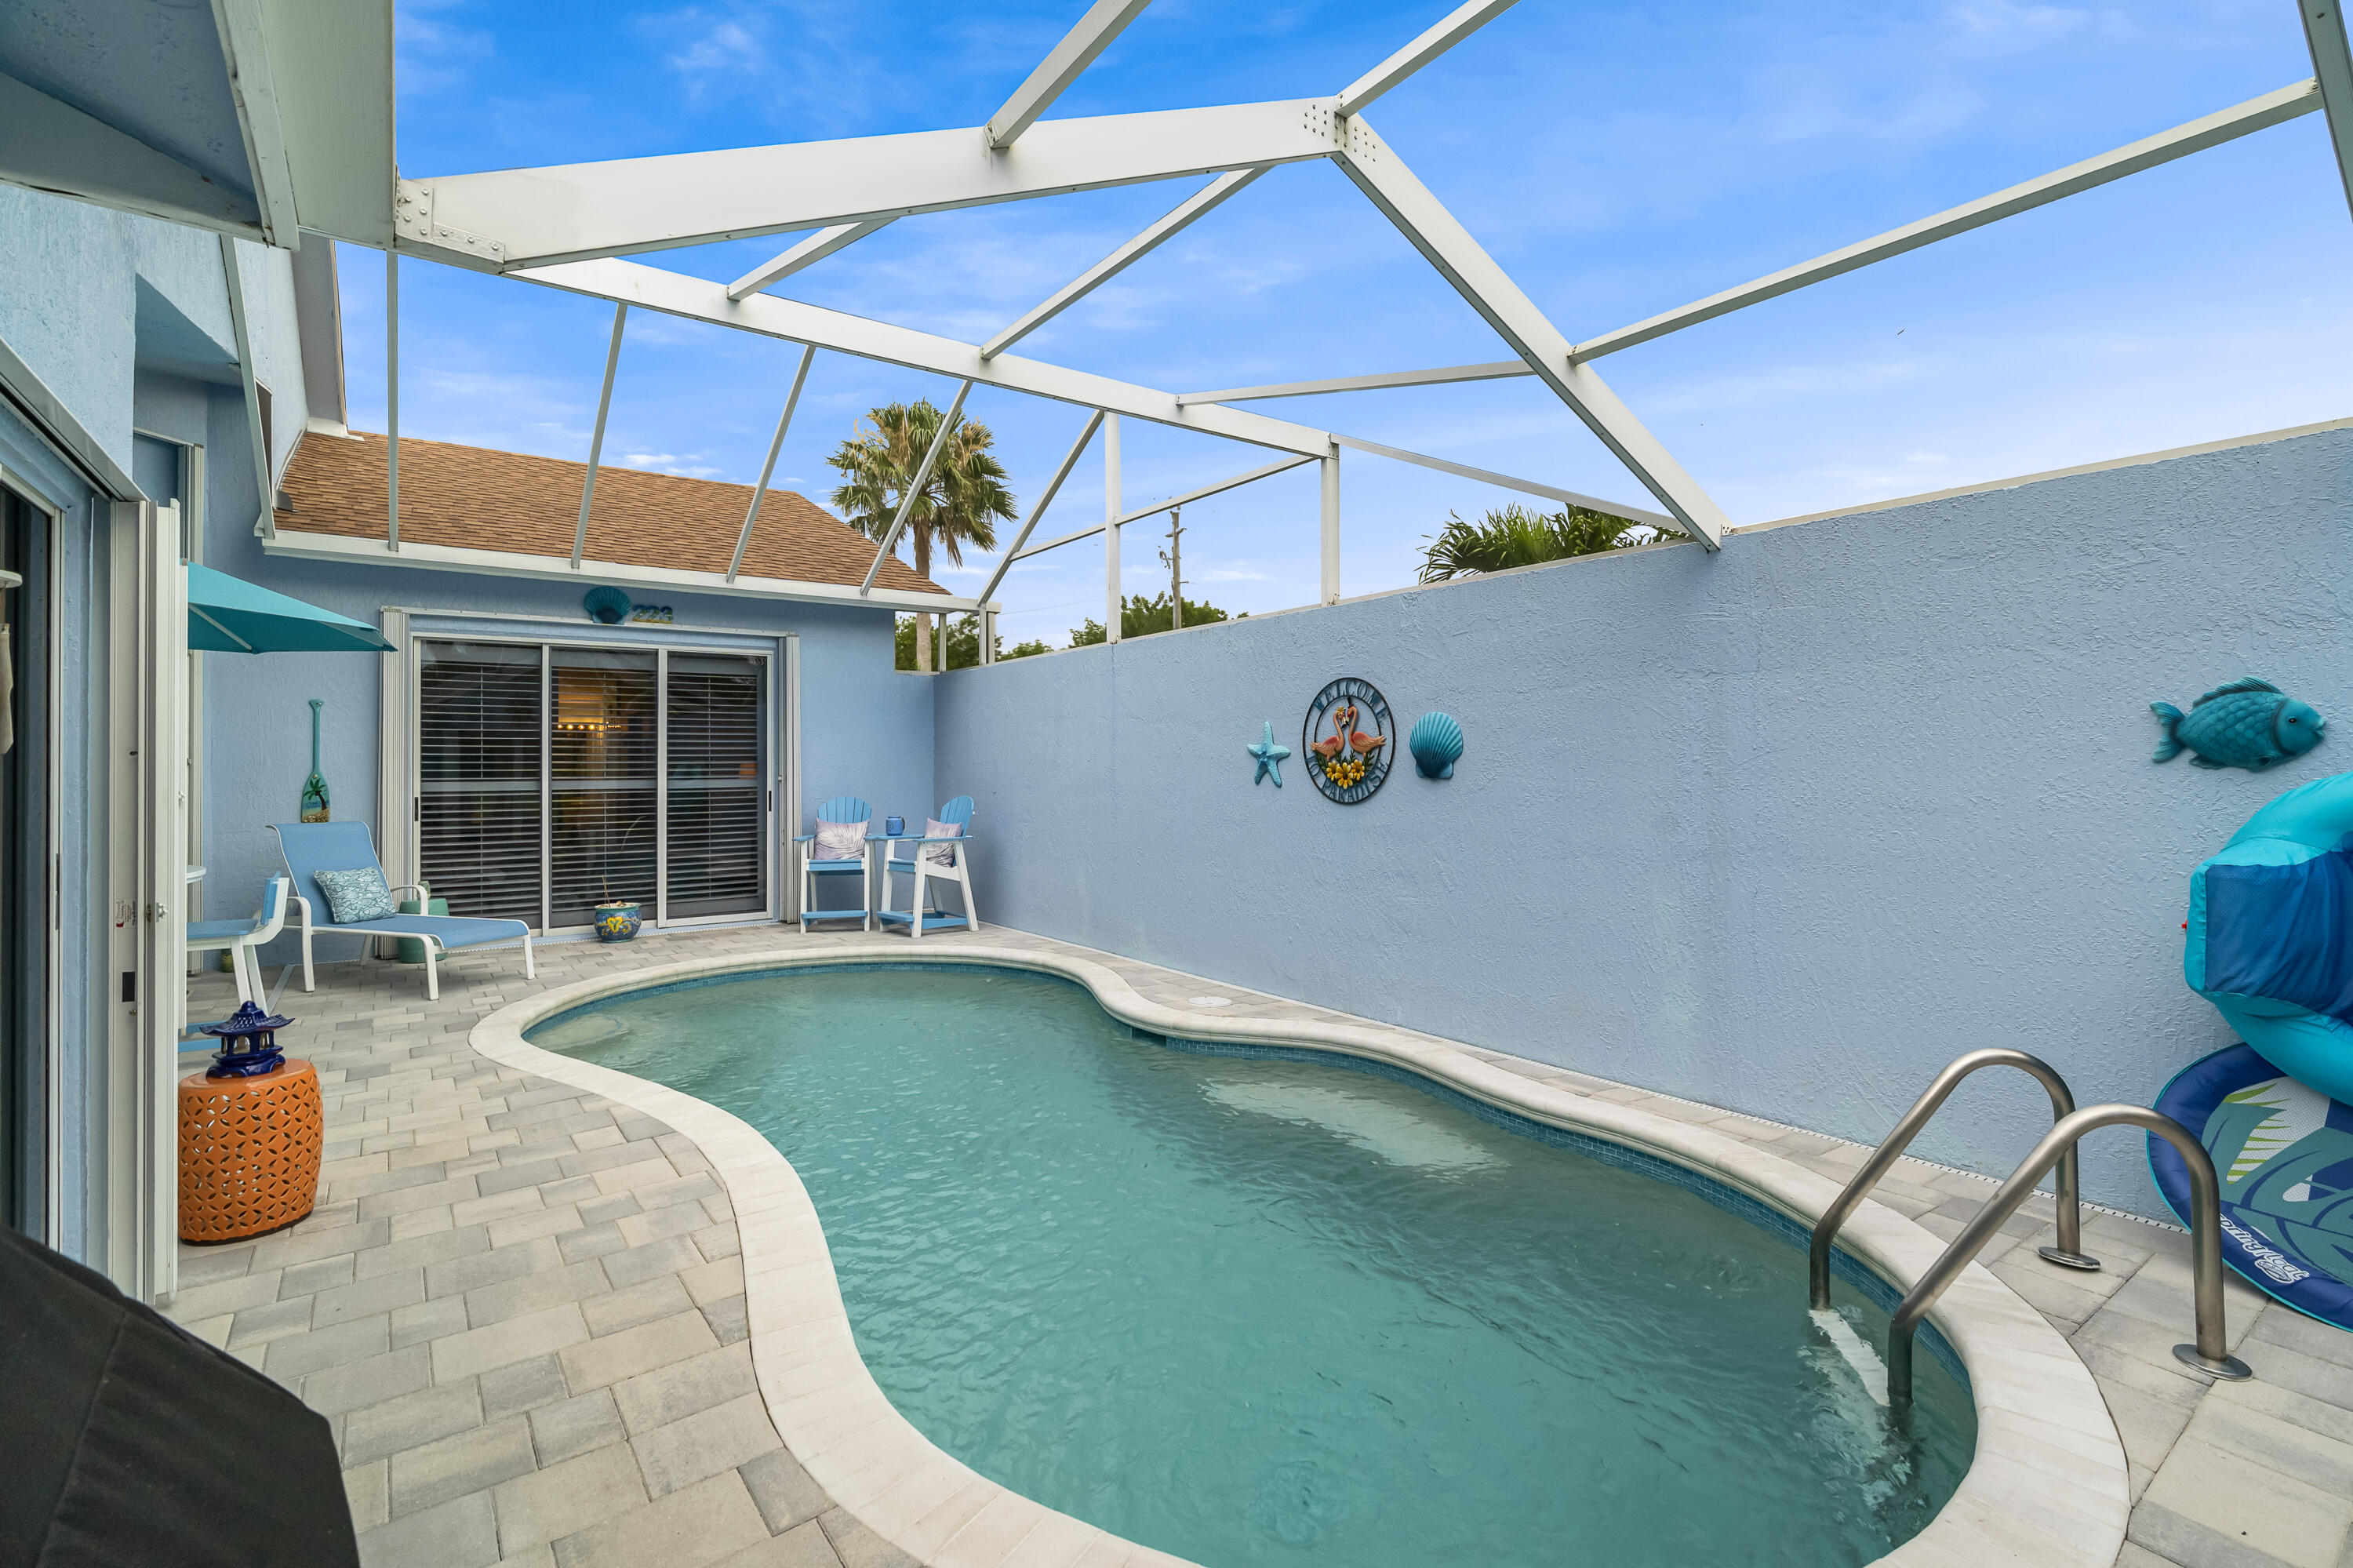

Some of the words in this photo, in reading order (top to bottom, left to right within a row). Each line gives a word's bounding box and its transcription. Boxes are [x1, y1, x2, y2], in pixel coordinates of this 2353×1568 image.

[632, 605, 673, 624] 223
[1312, 680, 1390, 724] WELCOME
[1305, 755, 1321, 777] TO
[1322, 762, 1390, 802] PARADISE
